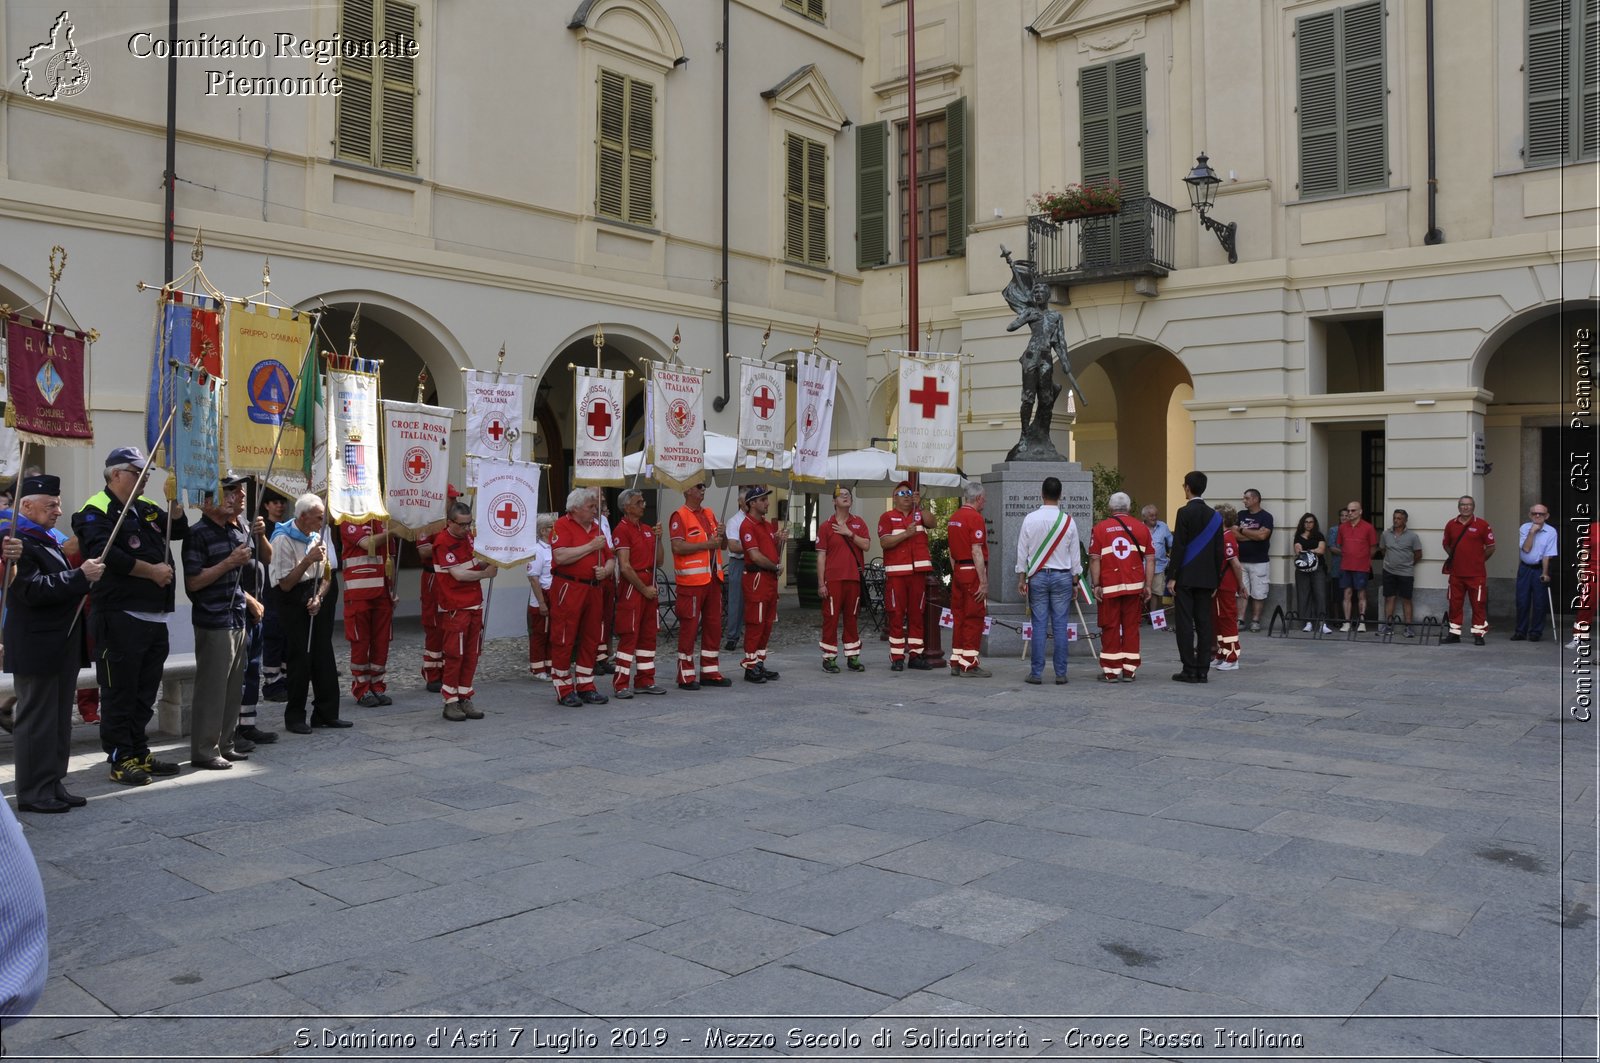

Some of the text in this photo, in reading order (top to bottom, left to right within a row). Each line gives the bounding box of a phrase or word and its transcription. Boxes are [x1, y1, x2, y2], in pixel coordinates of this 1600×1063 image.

[239, 327, 268, 338] GRUPPO
[658, 371, 700, 385] CROCE ROSSA
[475, 388, 515, 397] CROCE ROSSA
[665, 382, 694, 393] ITALIANA
[579, 392, 590, 418] CROCE
[391, 420, 447, 434] CROCE ROSSA
[899, 426, 929, 436] COMITATO
[400, 431, 438, 443] ITALIANA
[236, 445, 251, 454] SAN
[904, 440, 950, 450] SAN DAMIANO
[663, 446, 698, 455] MONTIGLIO
[659, 453, 701, 463] MONFERRATO
[389, 488, 444, 501] COMITATO LOCALE
[406, 498, 431, 508] CANELLI
